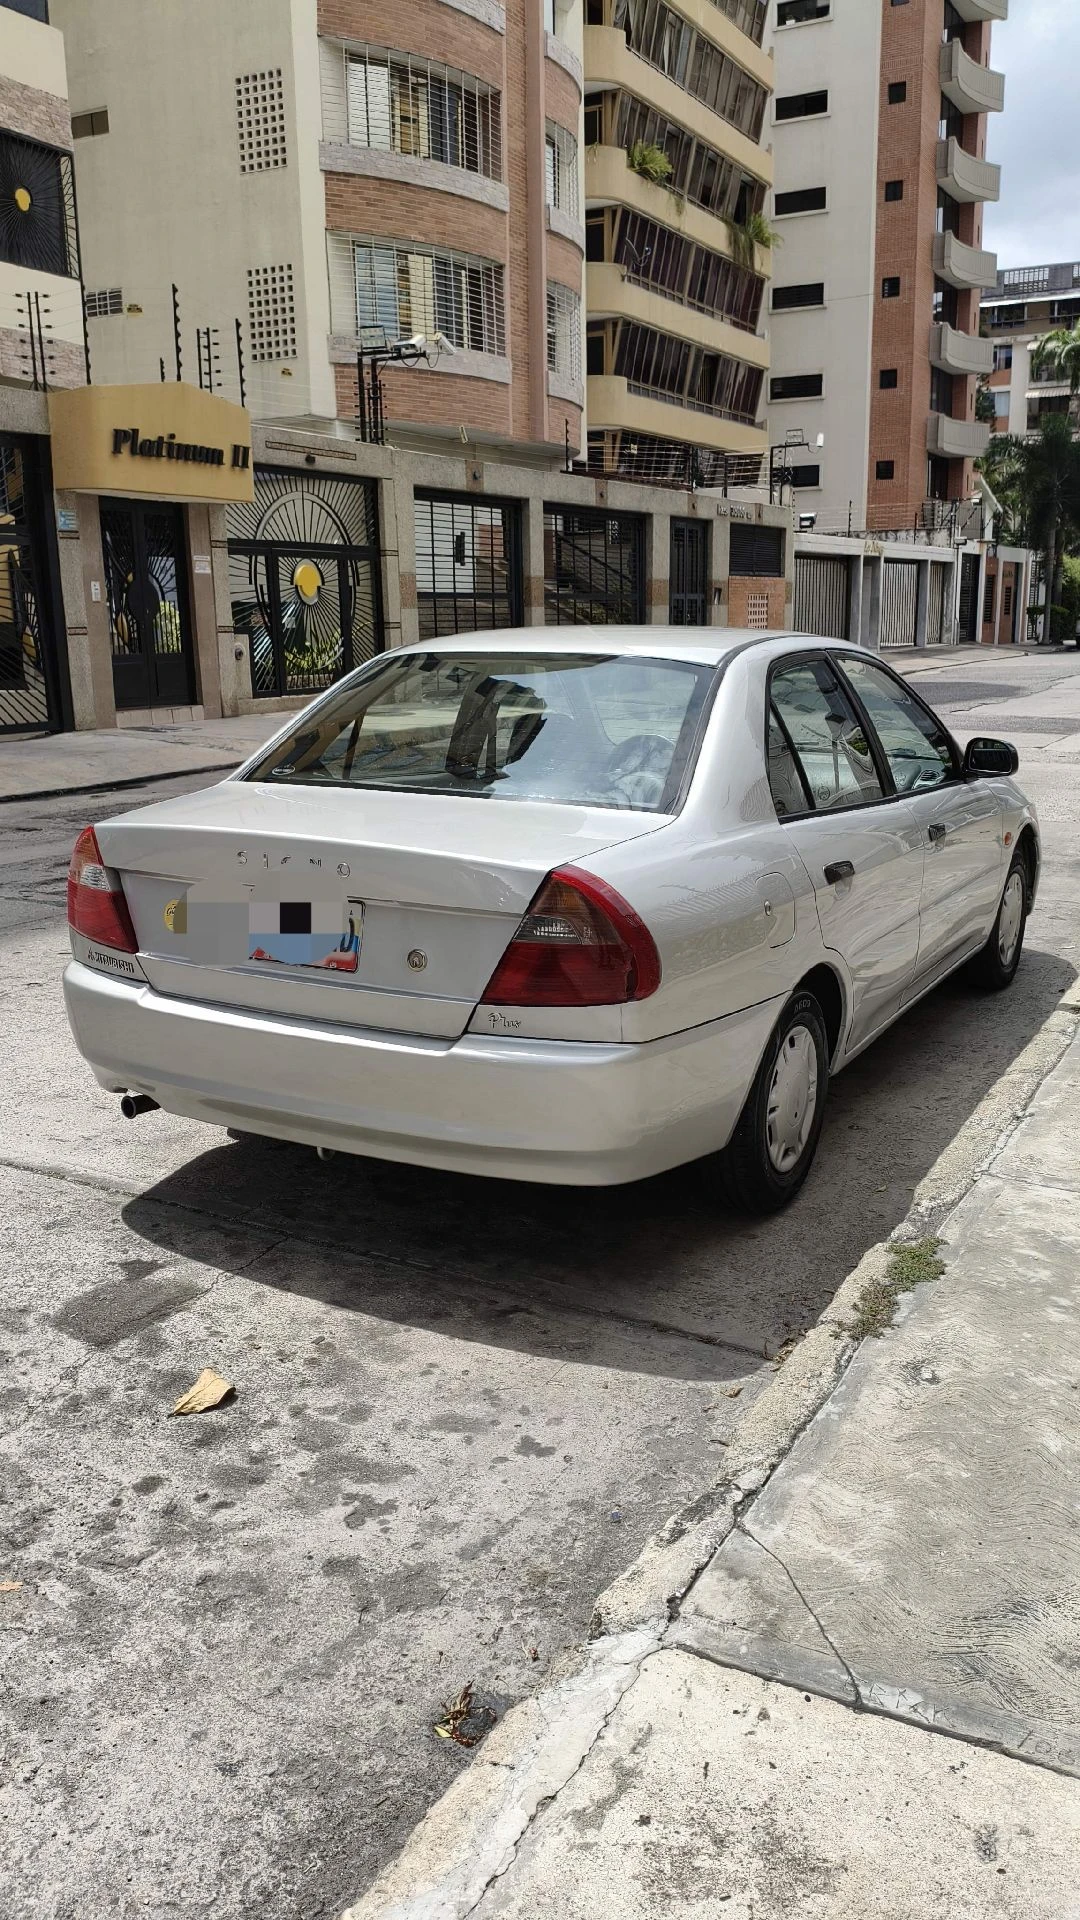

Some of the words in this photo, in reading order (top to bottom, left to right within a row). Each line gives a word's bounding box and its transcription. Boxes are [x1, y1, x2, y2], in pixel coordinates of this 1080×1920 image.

[111, 428, 225, 465] Platinum
[231, 444, 251, 469] II
[487, 1012, 521, 1028] Plus
